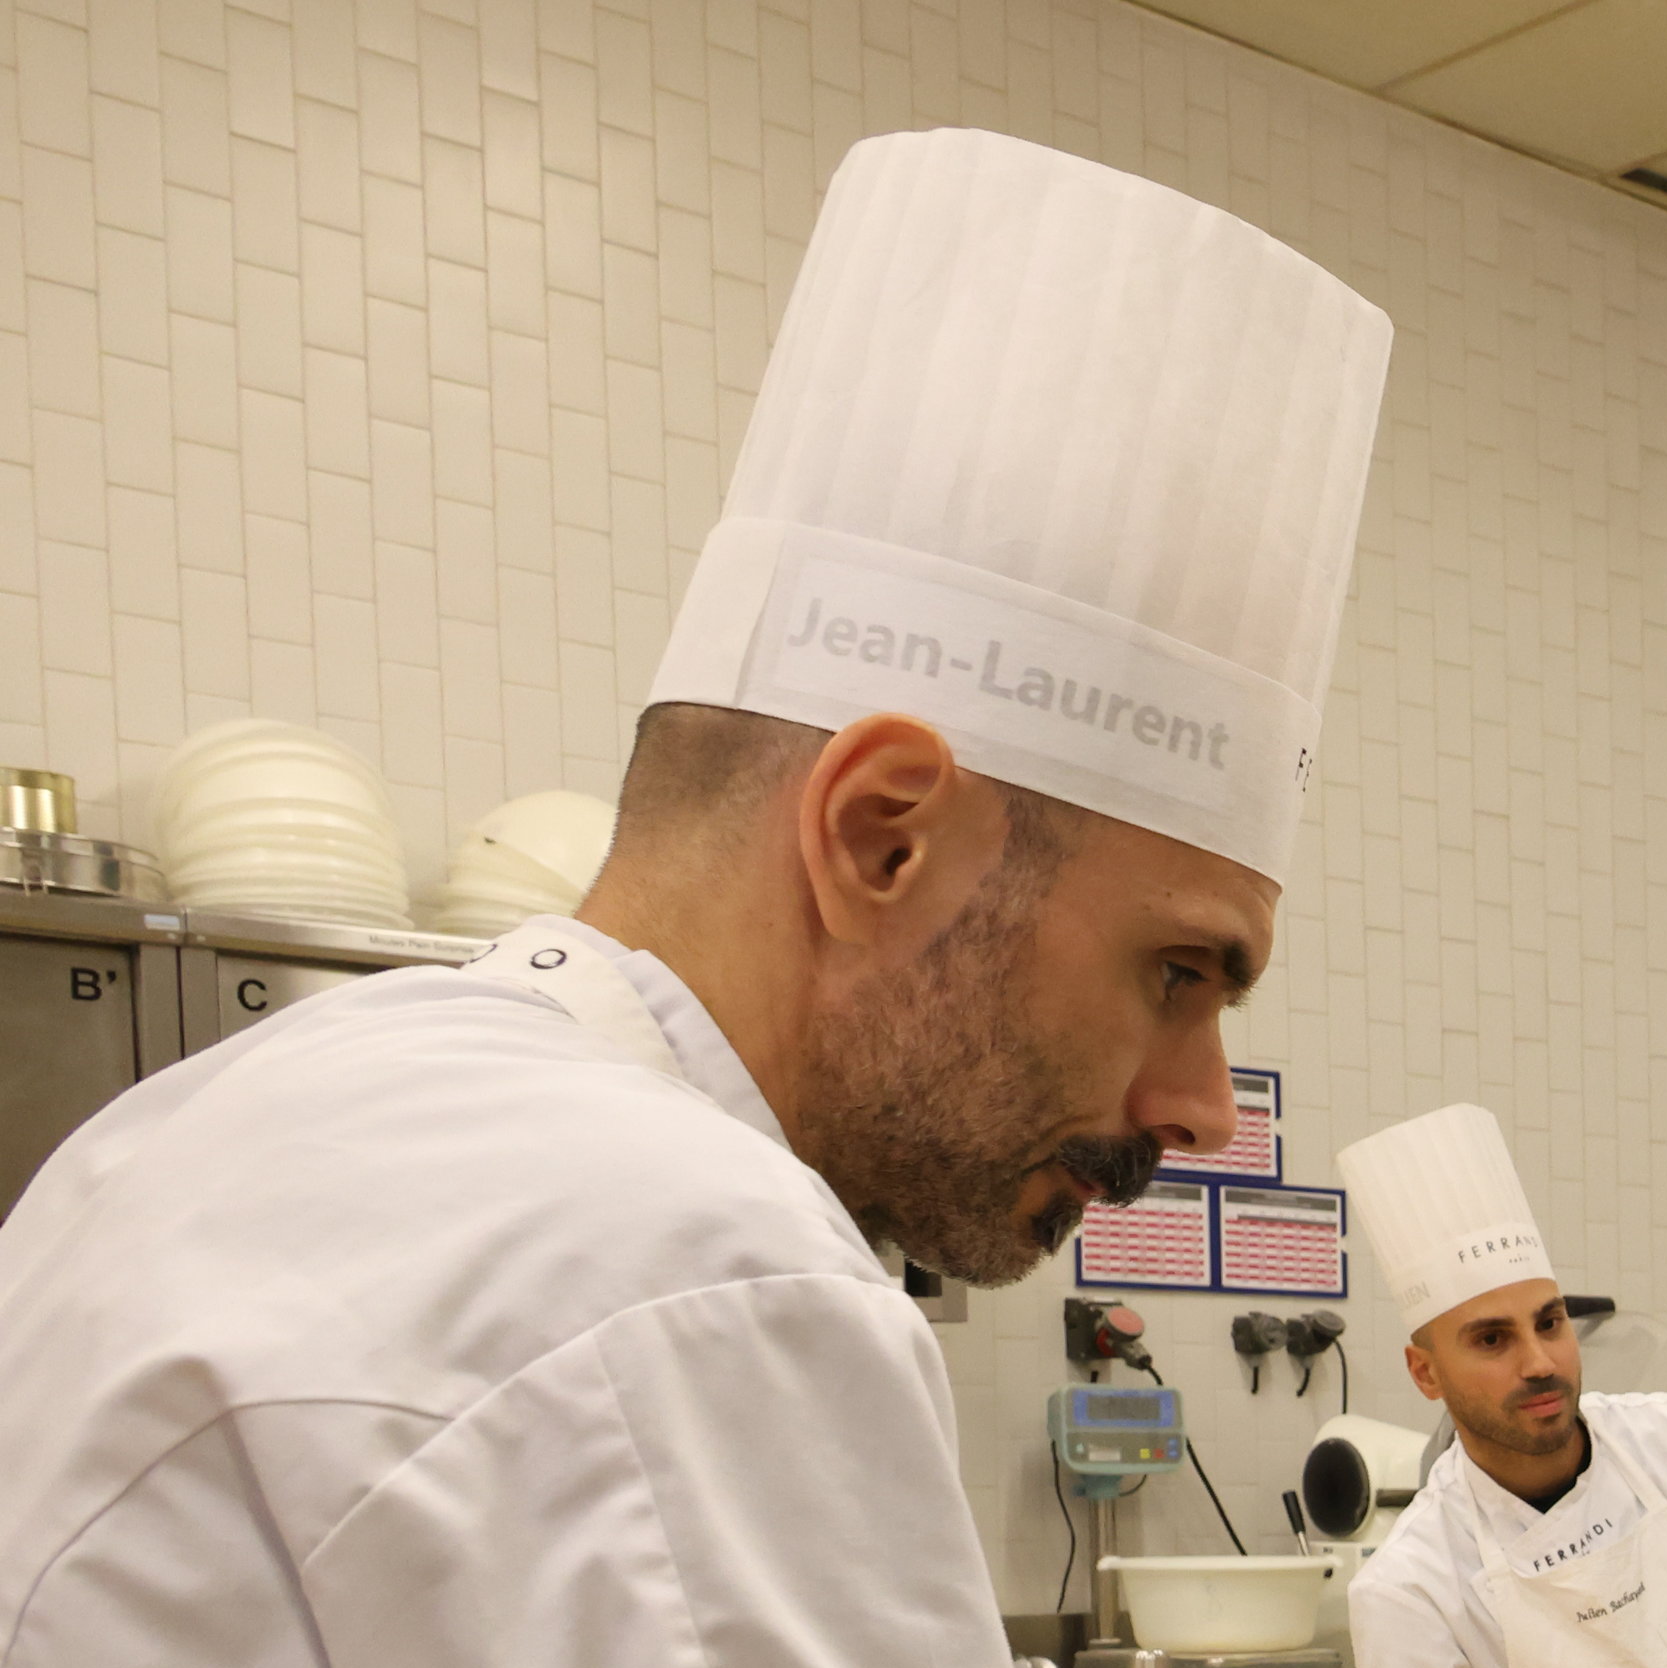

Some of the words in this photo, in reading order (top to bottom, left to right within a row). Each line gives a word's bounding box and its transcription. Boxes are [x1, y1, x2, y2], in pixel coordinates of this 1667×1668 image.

[787, 596, 1231, 771] Jean-Laurent
[237, 979, 268, 1012] C
[1532, 1517, 1614, 1573] FERRANDI
